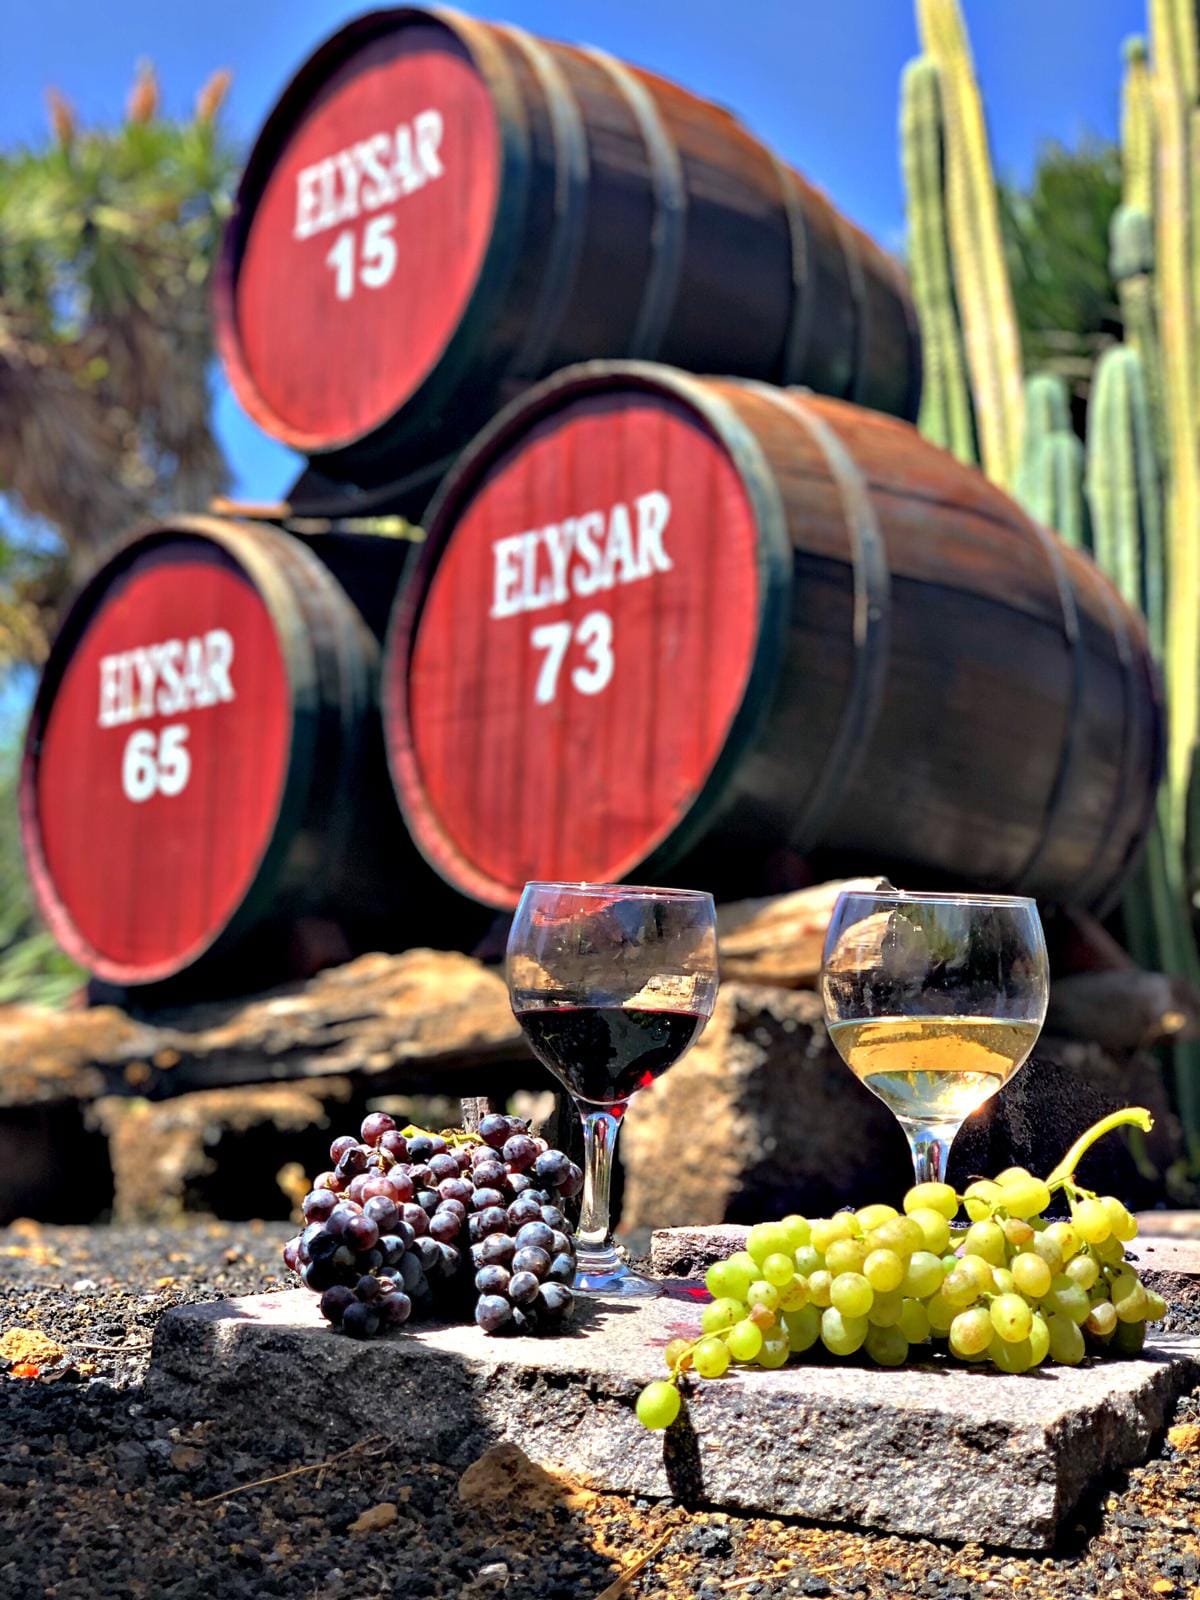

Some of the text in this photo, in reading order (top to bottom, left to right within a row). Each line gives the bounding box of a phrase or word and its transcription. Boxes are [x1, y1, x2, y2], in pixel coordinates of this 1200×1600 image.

[294, 109, 444, 240] ELYSAR
[326, 213, 398, 301] 15
[490, 490, 673, 619] ELYSAR
[98, 629, 235, 728] ELYSAR
[531, 611, 615, 705] 73
[122, 724, 191, 802] 65
